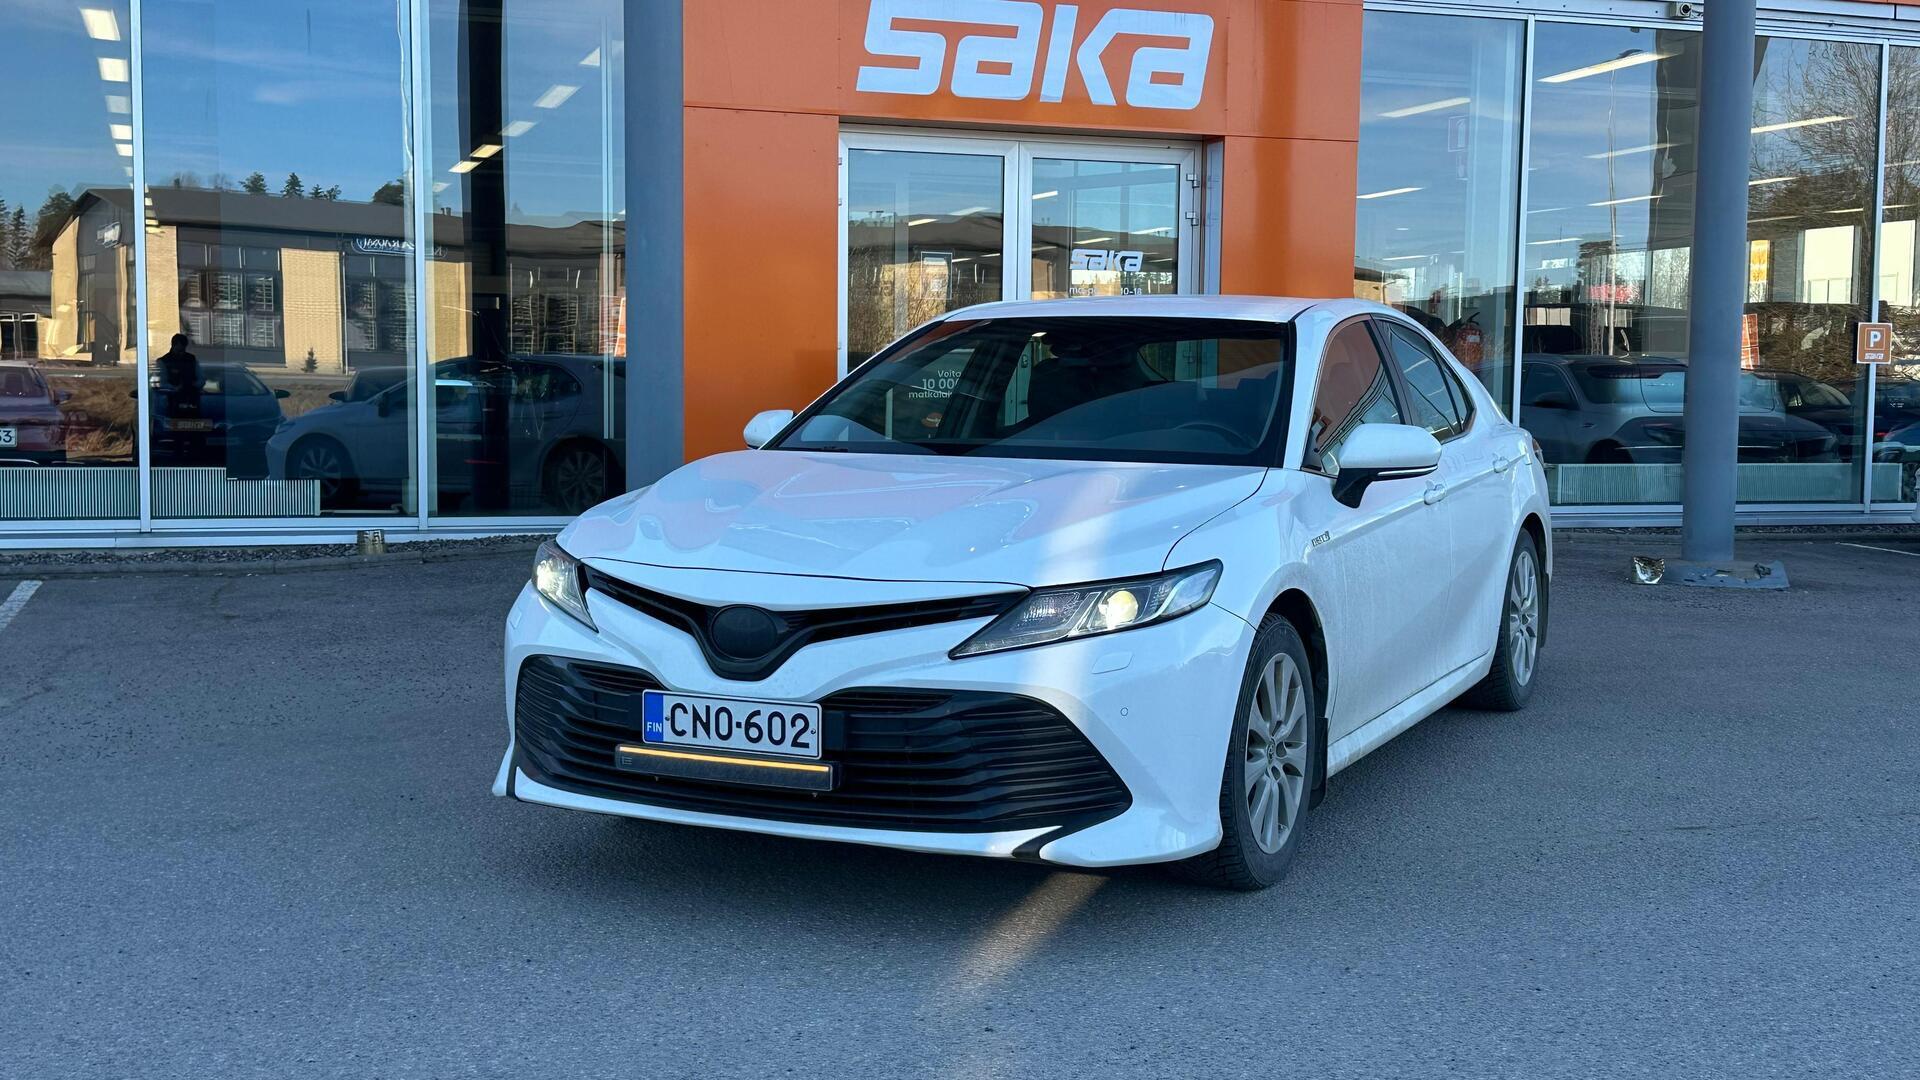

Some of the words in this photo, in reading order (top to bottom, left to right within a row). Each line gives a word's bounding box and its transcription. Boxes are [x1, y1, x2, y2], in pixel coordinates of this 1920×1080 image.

[1870, 331, 1882, 348] P
[922, 378, 936, 390] 10
[938, 378, 959, 390] 00
[646, 721, 663, 733] FIN
[670, 702, 810, 749] CNO-602
